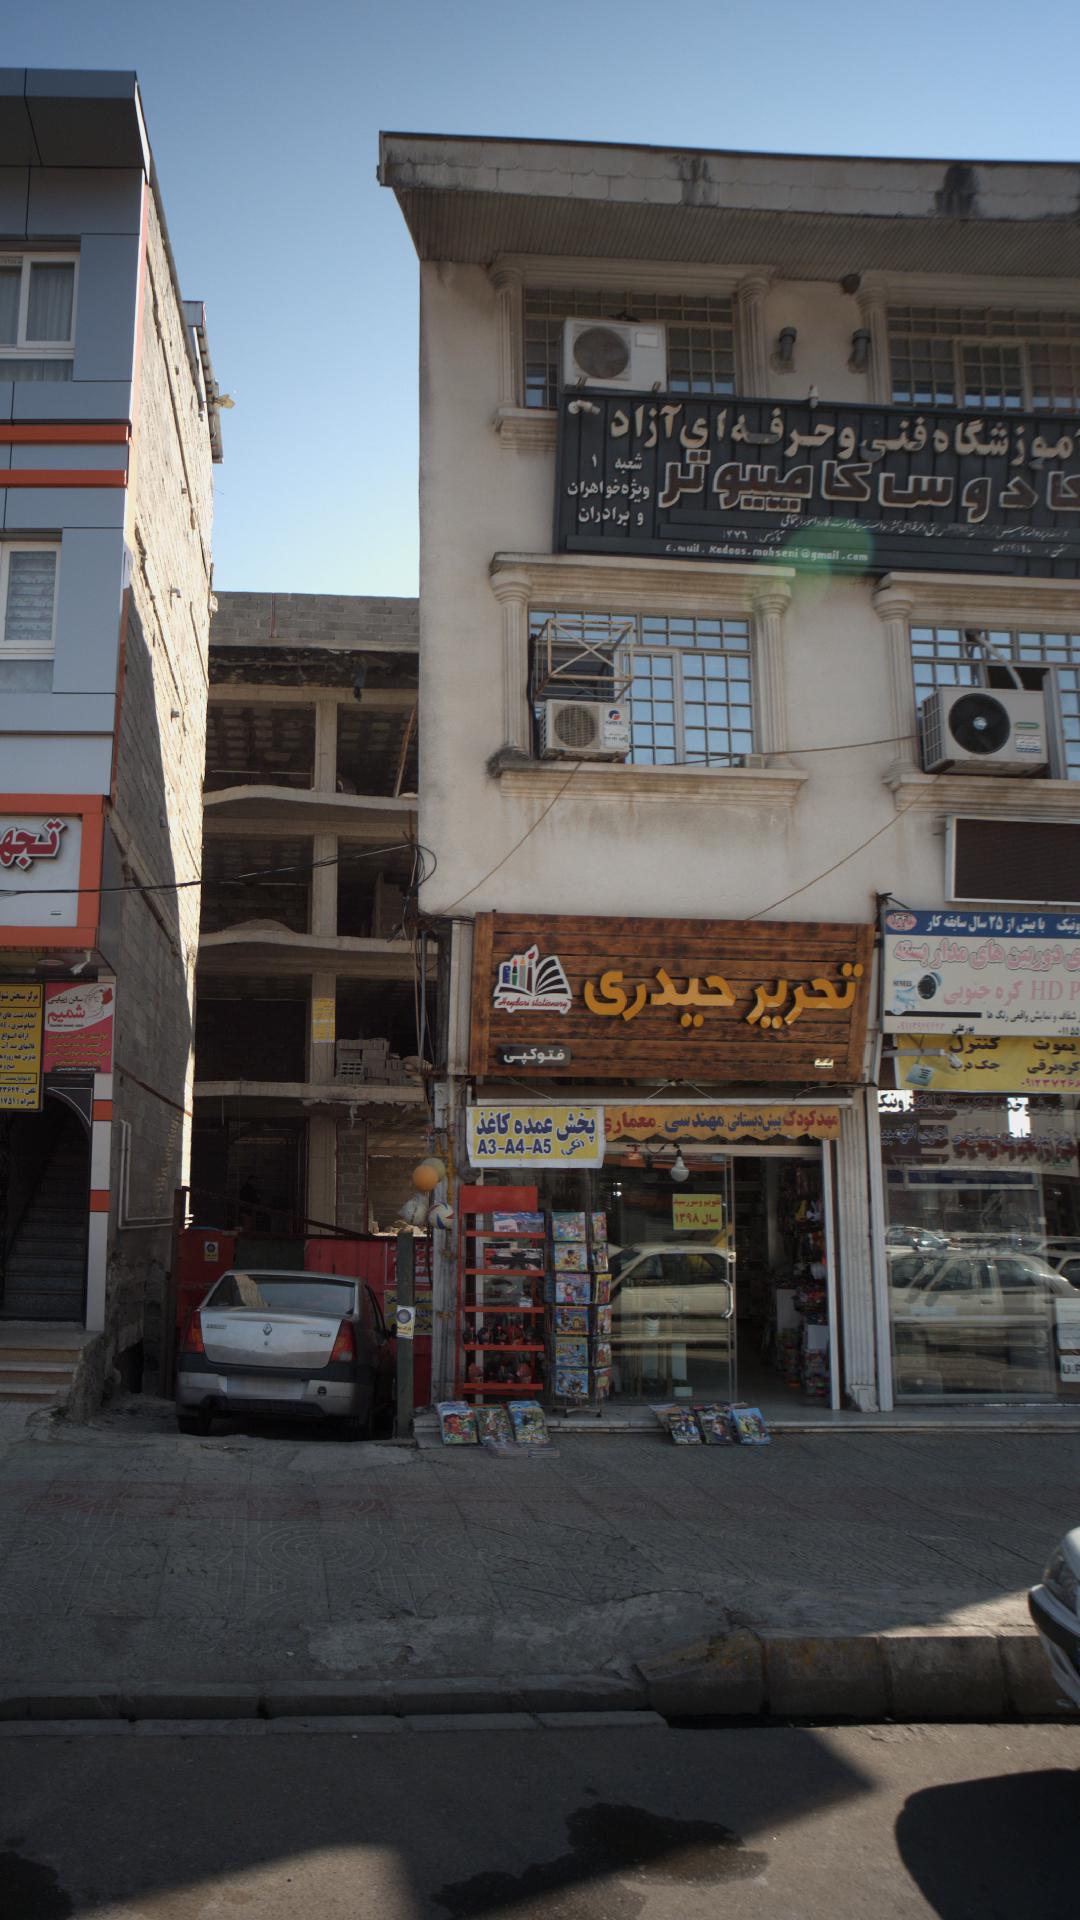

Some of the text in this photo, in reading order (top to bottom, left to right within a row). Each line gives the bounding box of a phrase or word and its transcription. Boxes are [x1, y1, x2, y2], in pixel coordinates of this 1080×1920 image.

[610, 404, 683, 448] آزاد
[615, 453, 643, 472] شعبه
[567, 479, 651, 504] ویژه خواهران
[658, 449, 874, 514] کامپیوتر
[578, 505, 644, 527] و برادران
[926, 915, 943, 932] کار
[943, 916, 967, 932] سابقه
[968, 916, 988, 933] سال
[1005, 917, 1016, 933] از
[1016, 916, 1036, 933] بیش
[969, 938, 1005, 970] های
[583, 962, 865, 1029] تحریر حیدری
[48, 1004, 85, 1024] شمیم
[503, 1048, 566, 1065] فتوکپی
[476, 1112, 595, 1143] پخش عمده کاغذ
[604, 1112, 656, 1134] معماری
[664, 1112, 724, 1132] مهندسی
[477, 1138, 551, 1154] A3-A4-A5
[675, 1212, 719, 1225] سال ۱۳۹۸
